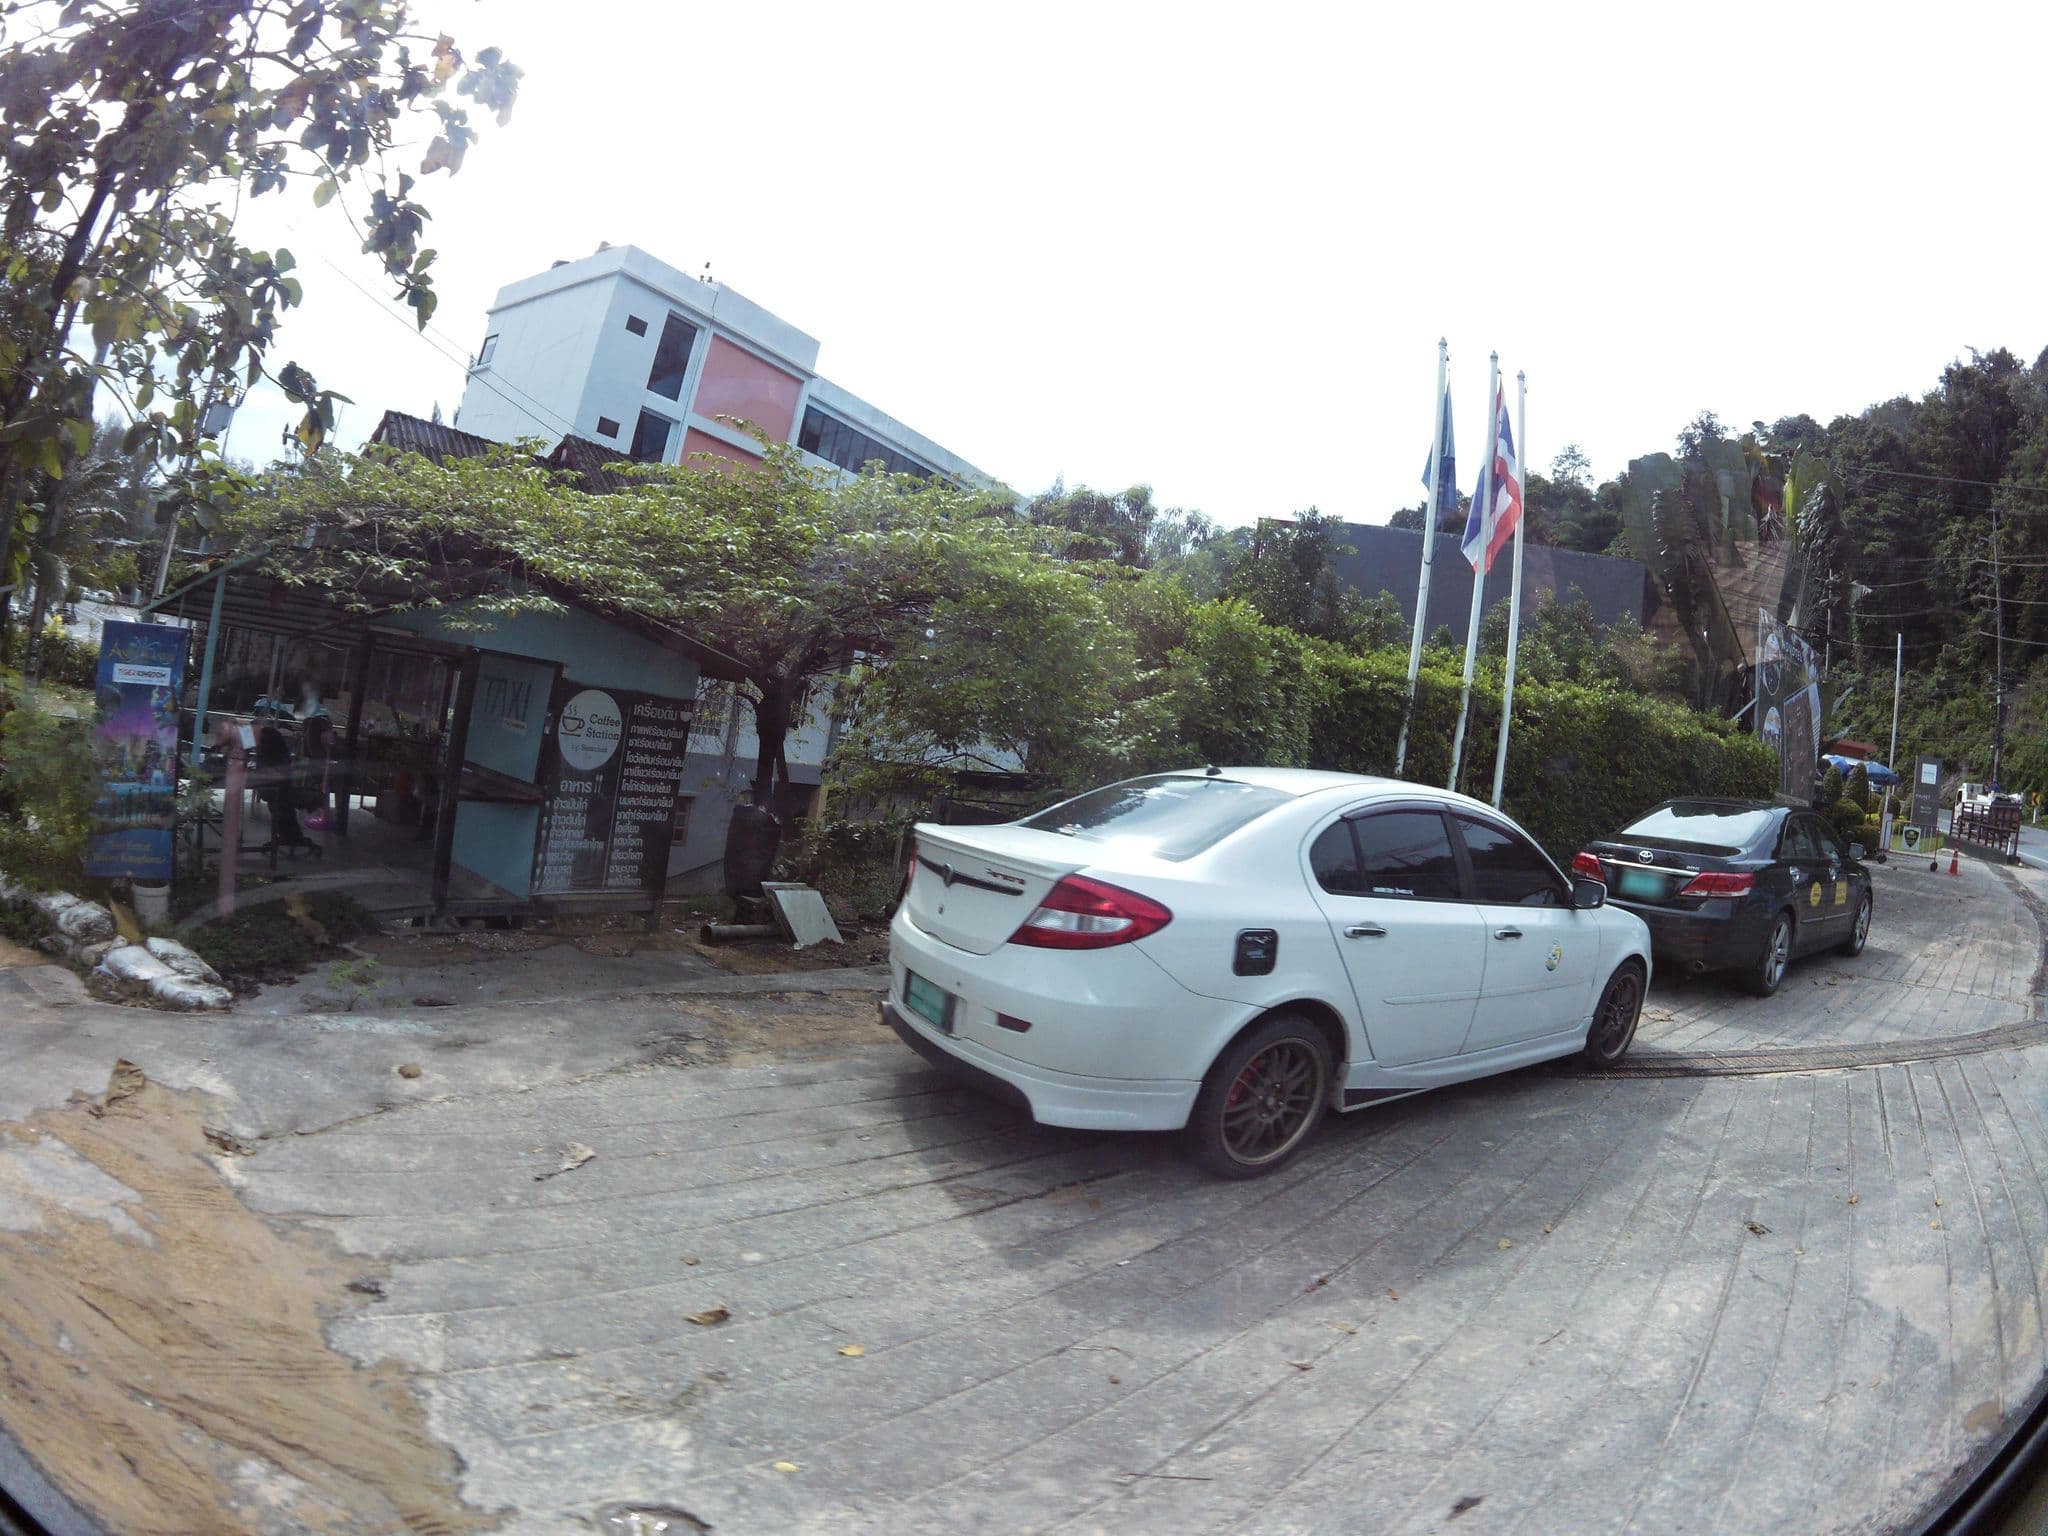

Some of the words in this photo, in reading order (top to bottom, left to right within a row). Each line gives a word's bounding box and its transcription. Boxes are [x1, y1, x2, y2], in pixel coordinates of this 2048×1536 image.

[483, 675, 532, 722] TAXI
[585, 727, 620, 740] Station
[560, 780, 593, 793] อาหาร
